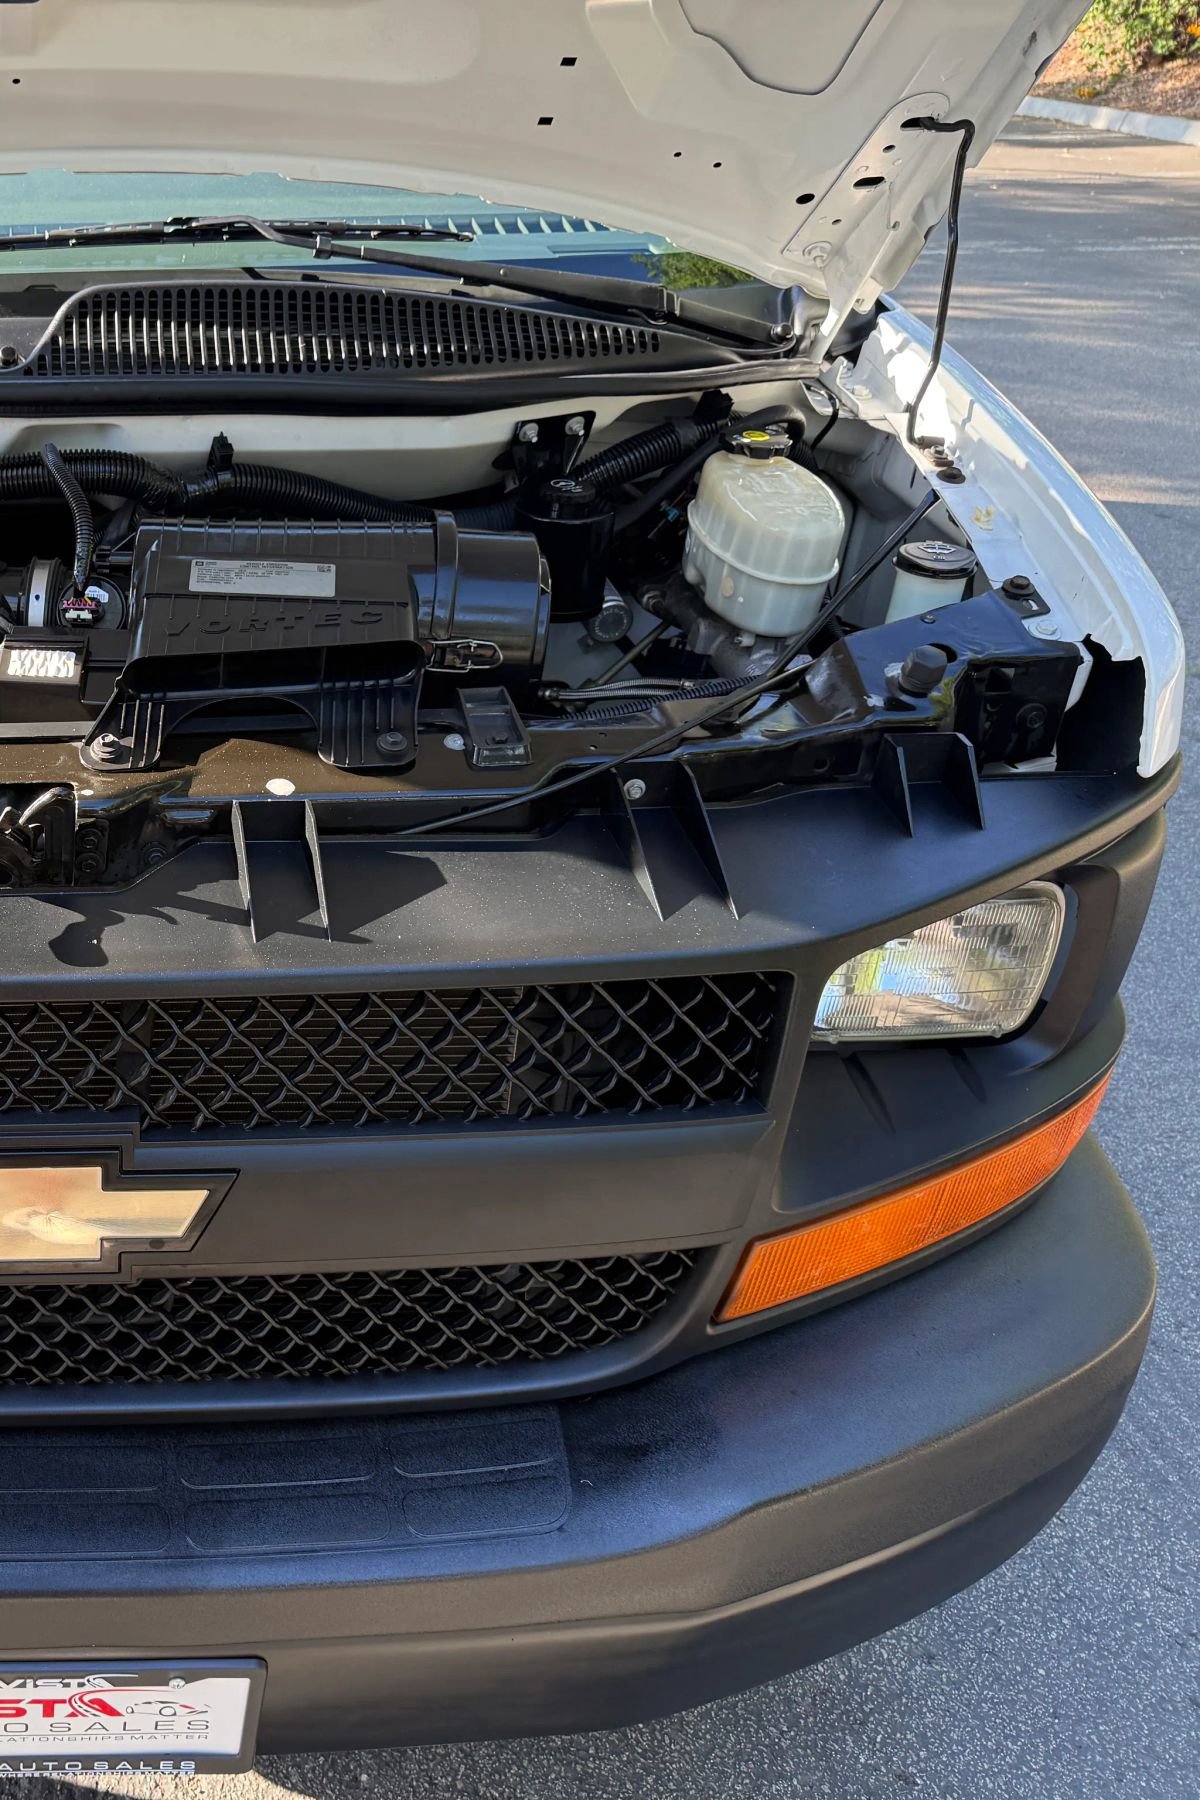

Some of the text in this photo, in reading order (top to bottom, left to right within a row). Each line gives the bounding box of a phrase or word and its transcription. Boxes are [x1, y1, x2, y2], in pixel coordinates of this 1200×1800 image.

[165, 611, 383, 637] VORTEC
[49, 1720, 209, 1733] SALES
[93, 1760, 196, 1771] SALES
